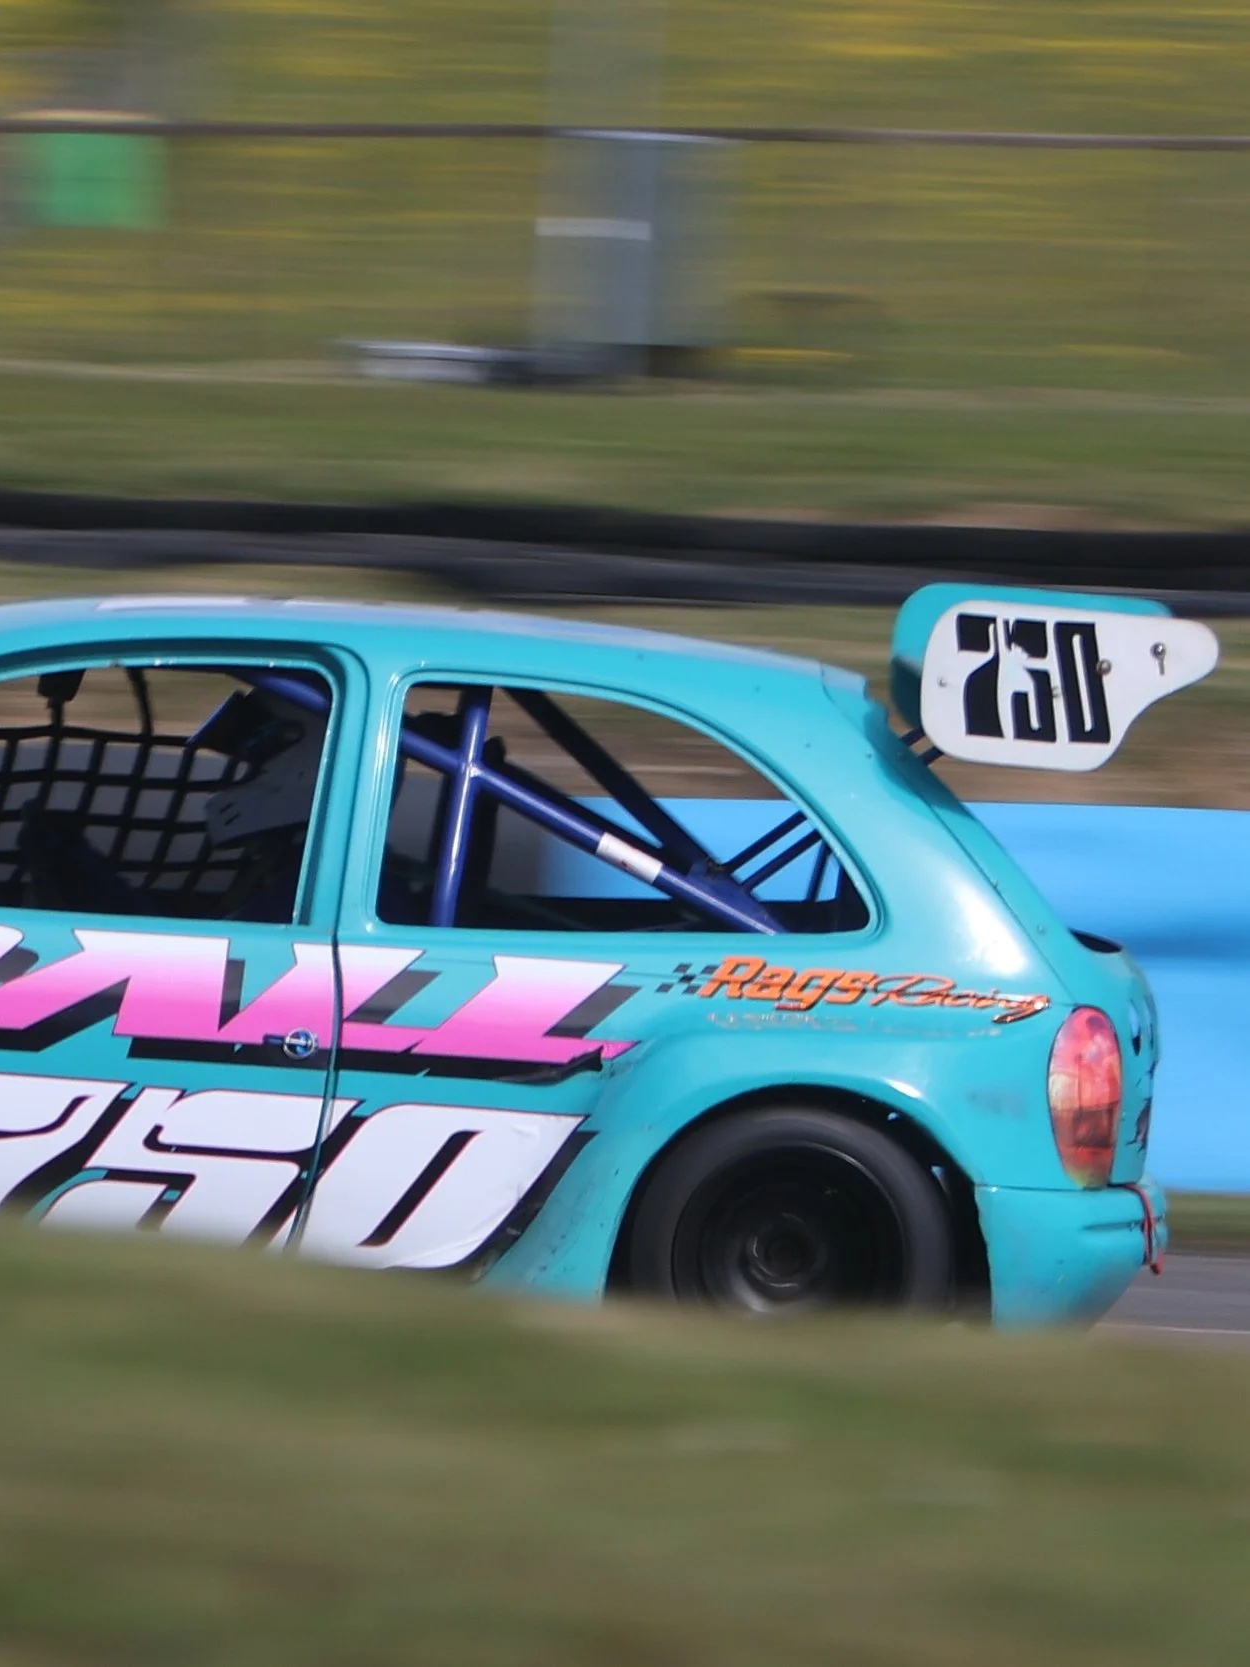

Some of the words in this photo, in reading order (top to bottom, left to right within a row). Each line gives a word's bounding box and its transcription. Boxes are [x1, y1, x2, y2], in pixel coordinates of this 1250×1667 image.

[955, 613, 1112, 745] 750
[699, 955, 880, 1011] Rags
[866, 966, 1050, 1024] Racing
